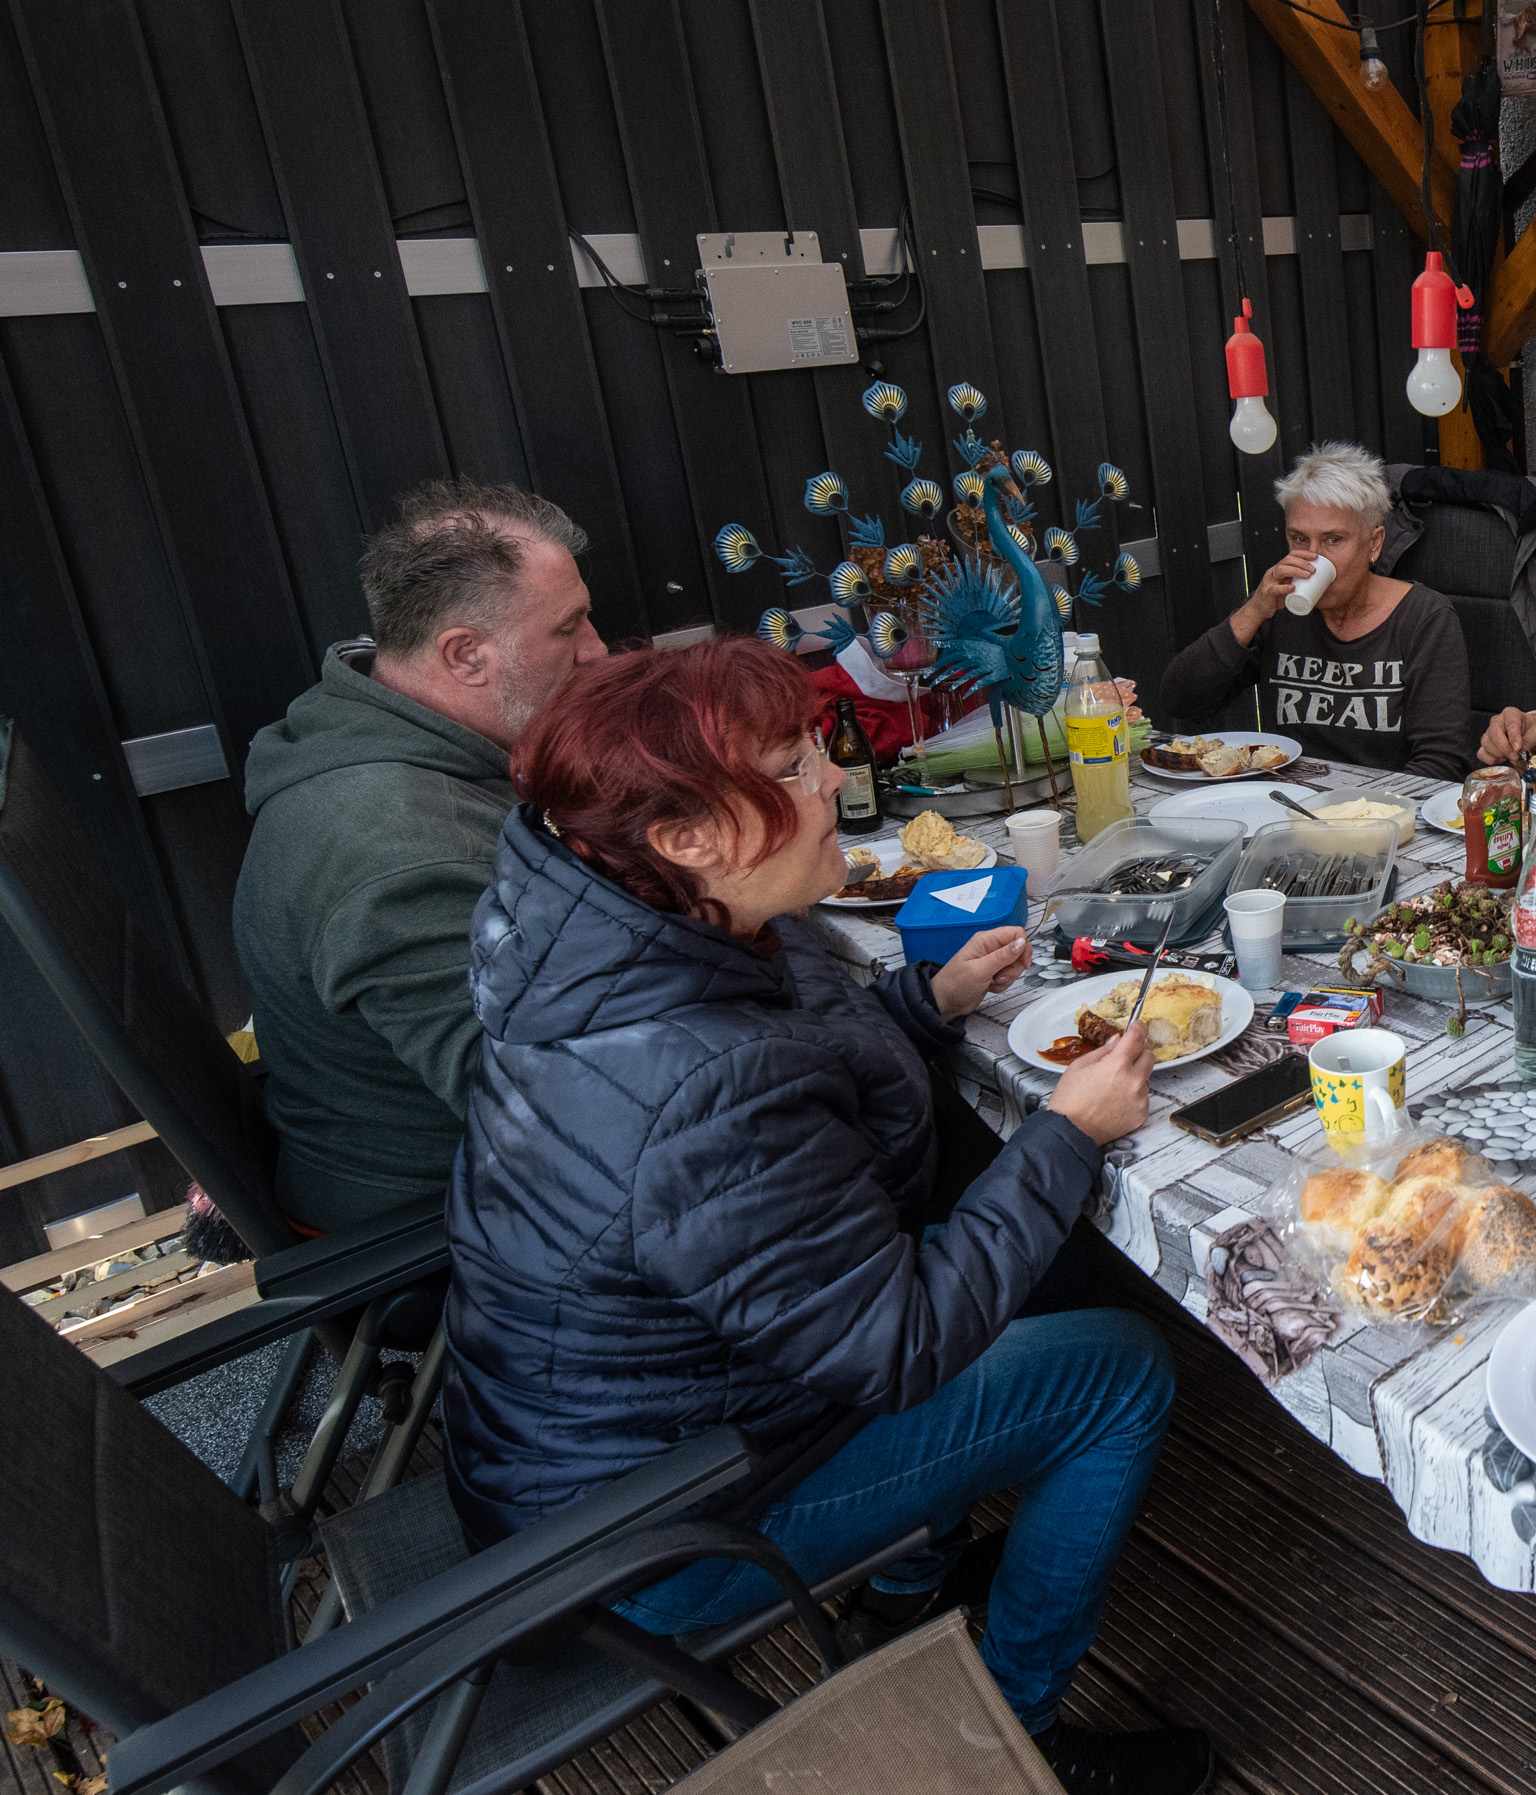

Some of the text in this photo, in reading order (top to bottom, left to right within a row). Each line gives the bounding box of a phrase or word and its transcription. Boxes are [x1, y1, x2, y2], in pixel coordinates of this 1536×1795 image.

[1277, 652, 1404, 686] KEEP IT
[1276, 688, 1402, 732] REAL
